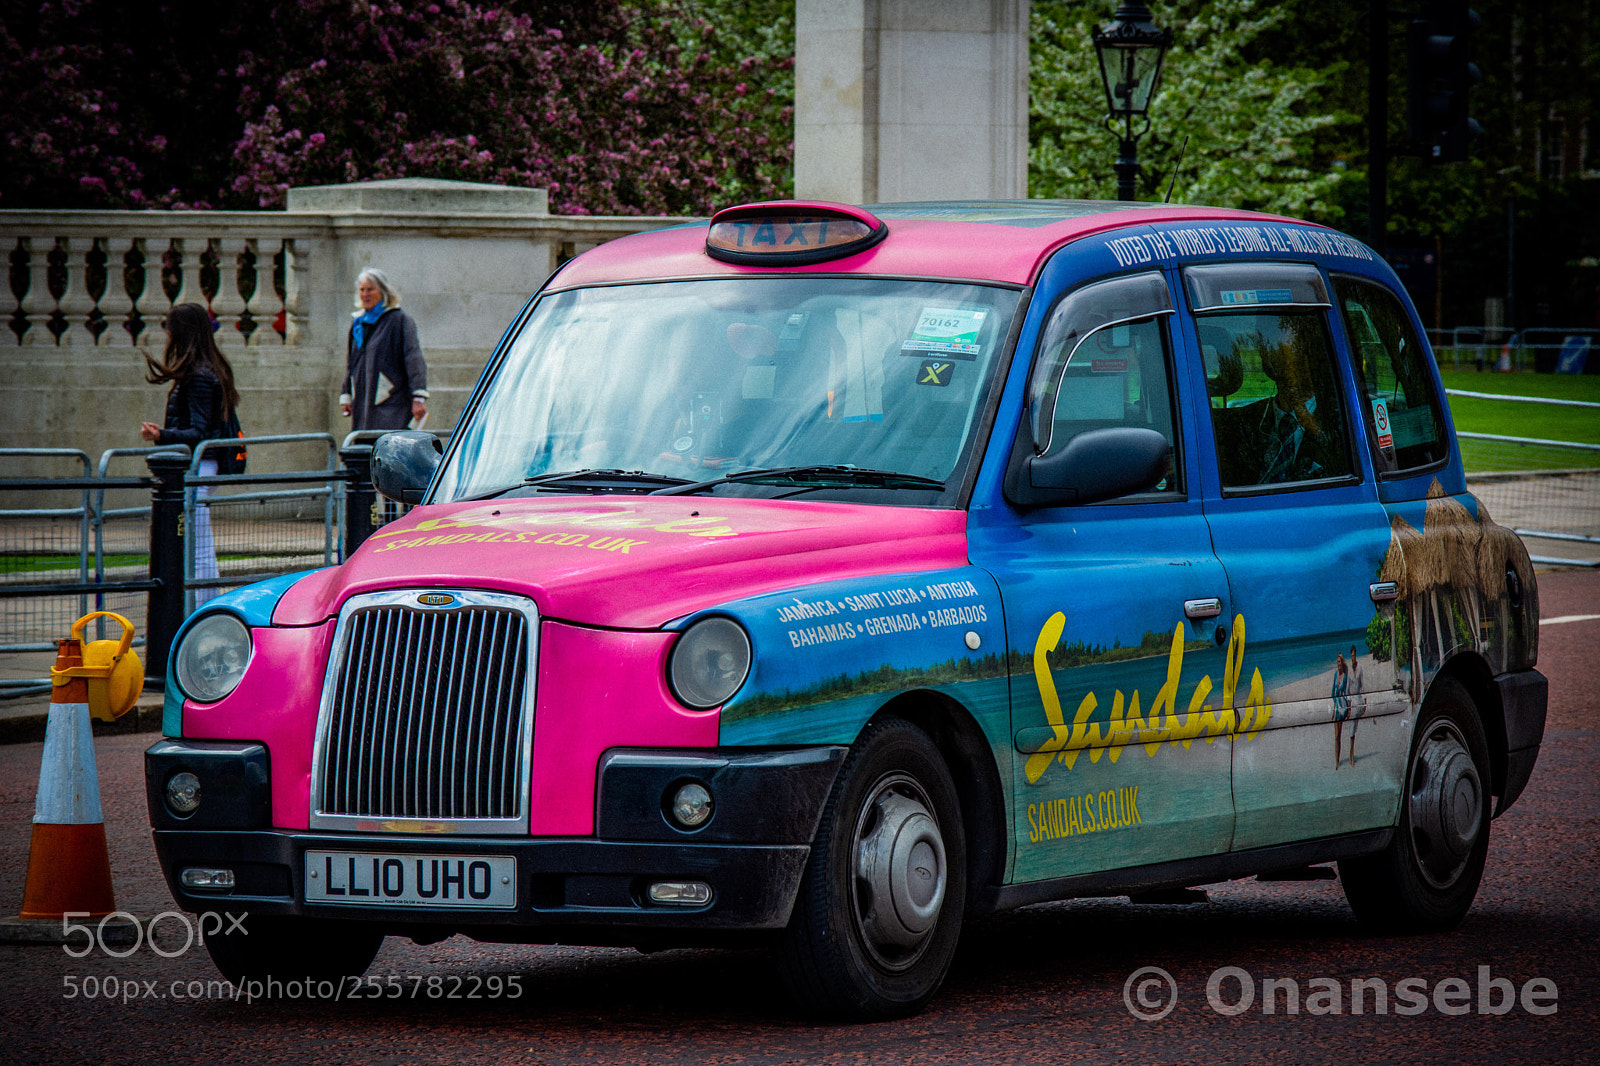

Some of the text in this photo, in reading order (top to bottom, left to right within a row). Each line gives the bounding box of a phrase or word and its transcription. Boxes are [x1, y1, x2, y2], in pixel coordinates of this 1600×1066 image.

[732, 218, 830, 247] TAXI
[1104, 235, 1152, 267] VOTED
[1142, 231, 1176, 260] THE
[1167, 227, 1226, 256] WORLD'S
[1218, 226, 1270, 253] LEADING
[1263, 227, 1338, 256] ALL-INCLUSIVE
[921, 317, 960, 328] 70162
[374, 530, 649, 555] SANDALS.CO.UK
[776, 580, 979, 623] JAMAICA SAINT LUCIA ANTIGUA
[788, 604, 988, 649] BAHAMAS GRENADA BARBADOS
[1024, 611, 1272, 784] Sandals
[1027, 785, 1142, 843] SANDALS.CO.UK
[325, 856, 492, 900] LL10 UHO
